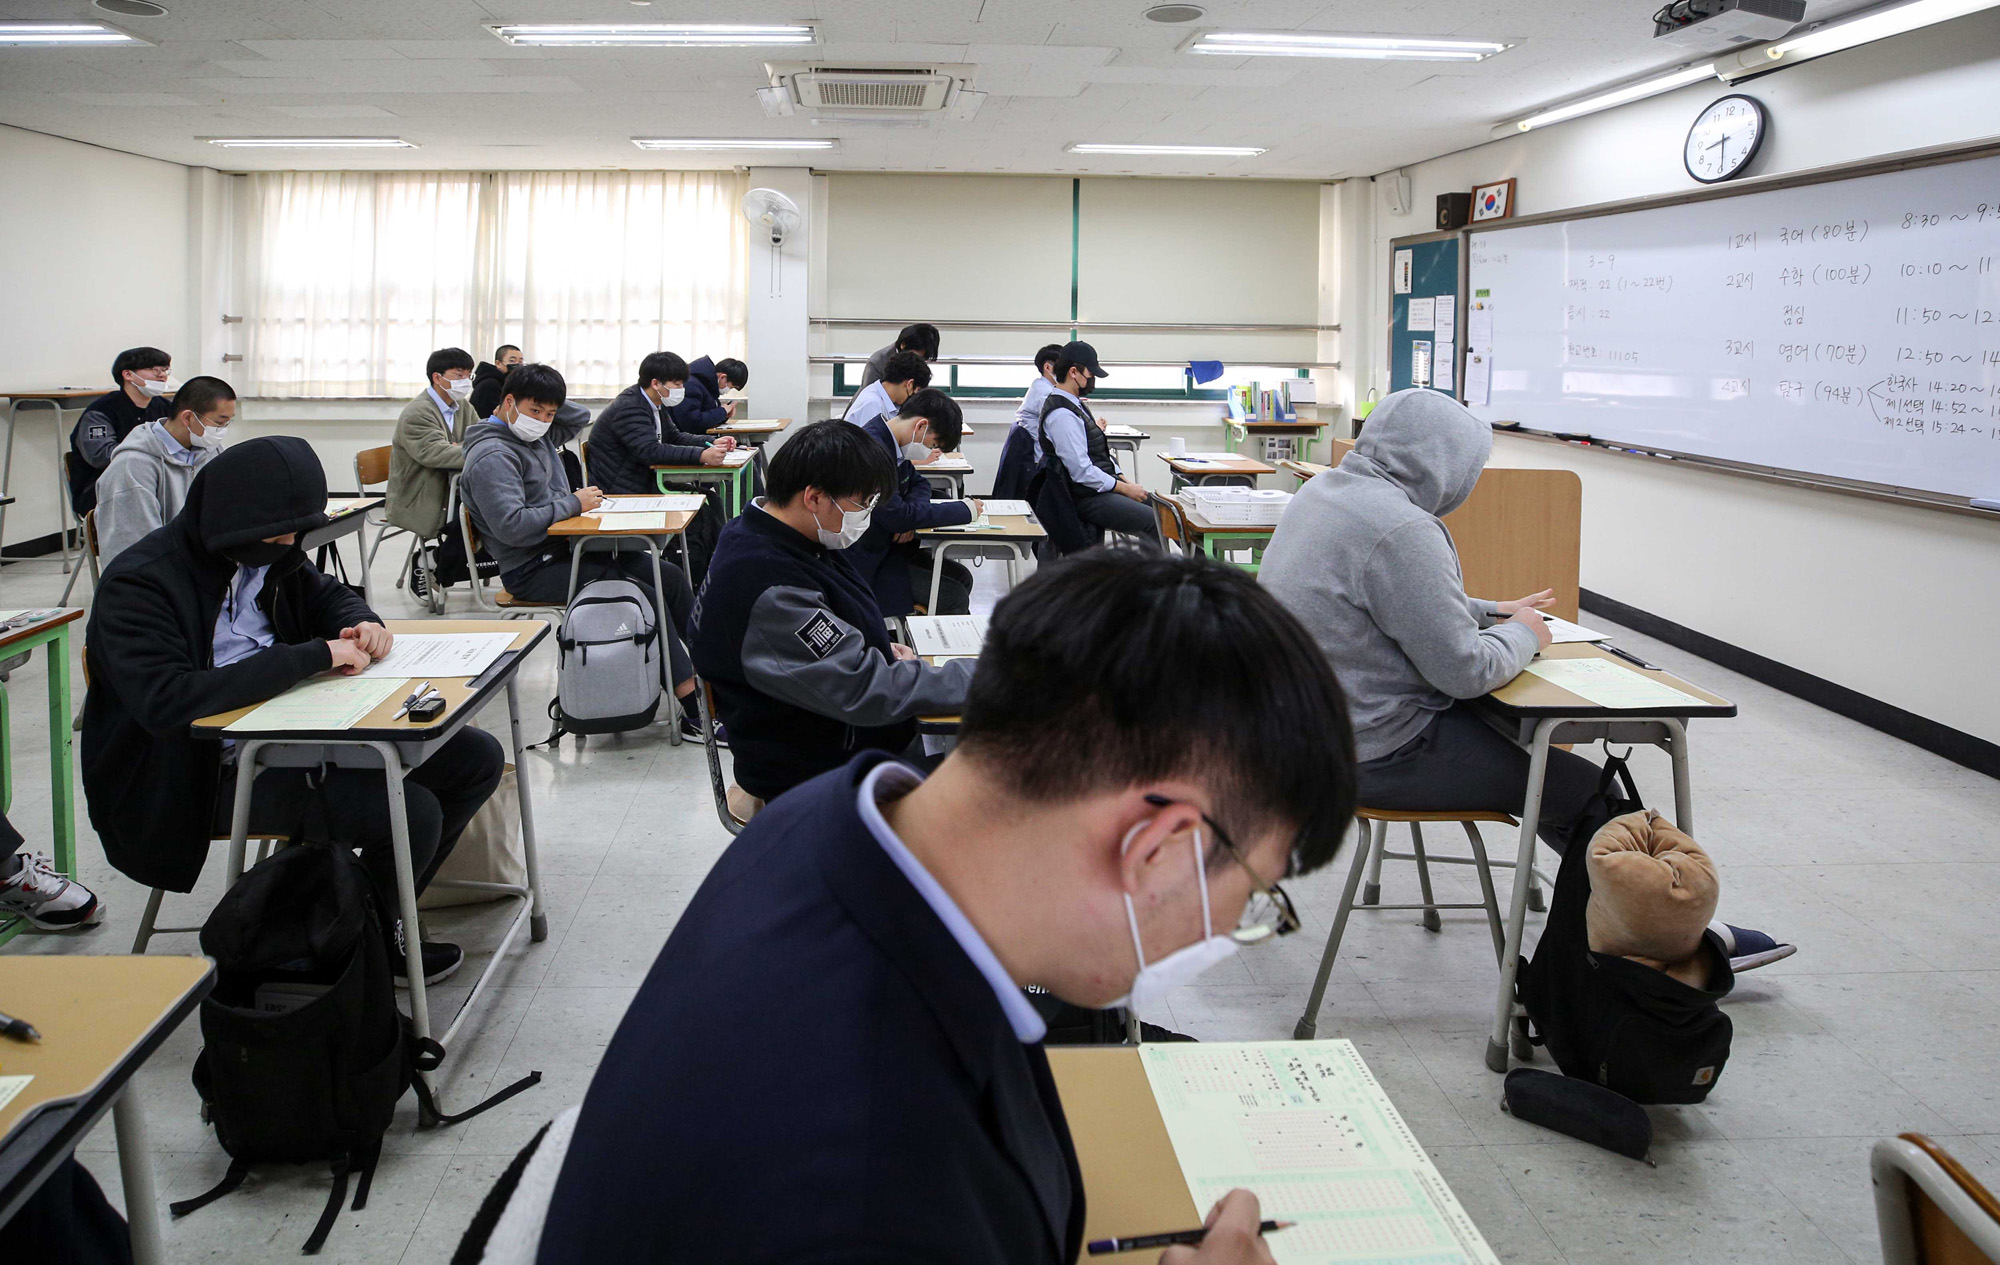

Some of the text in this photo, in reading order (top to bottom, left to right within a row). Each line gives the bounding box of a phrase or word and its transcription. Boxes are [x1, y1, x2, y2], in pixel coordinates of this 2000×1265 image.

[1725, 105, 1736, 117] 12
[1713, 114, 1721, 123] 11
[1749, 129, 1755, 140] 3
[1697, 141, 1704, 151] 9
[1741, 146, 1747, 156] 4
[1698, 155, 1704, 165] 8
[1731, 158, 1737, 168] 5
[1706, 163, 1712, 172] 7
[1717, 165, 1723, 174] 6
[1728, 231, 1757, 252] 1교시
[1901, 212, 1940, 230] 8:30
[1726, 271, 1754, 290] 2교시
[1901, 261, 1942, 278] 10:10
[1896, 307, 1942, 325] 11:50
[1725, 340, 1754, 359] 3교시
[1897, 347, 1944, 364] 12:50
[1928, 381, 1967, 394] 14:20
[1931, 398, 1967, 415] 14:52
[1931, 420, 1966, 435] 15:24
[466, 560, 498, 568] CVERNAT
